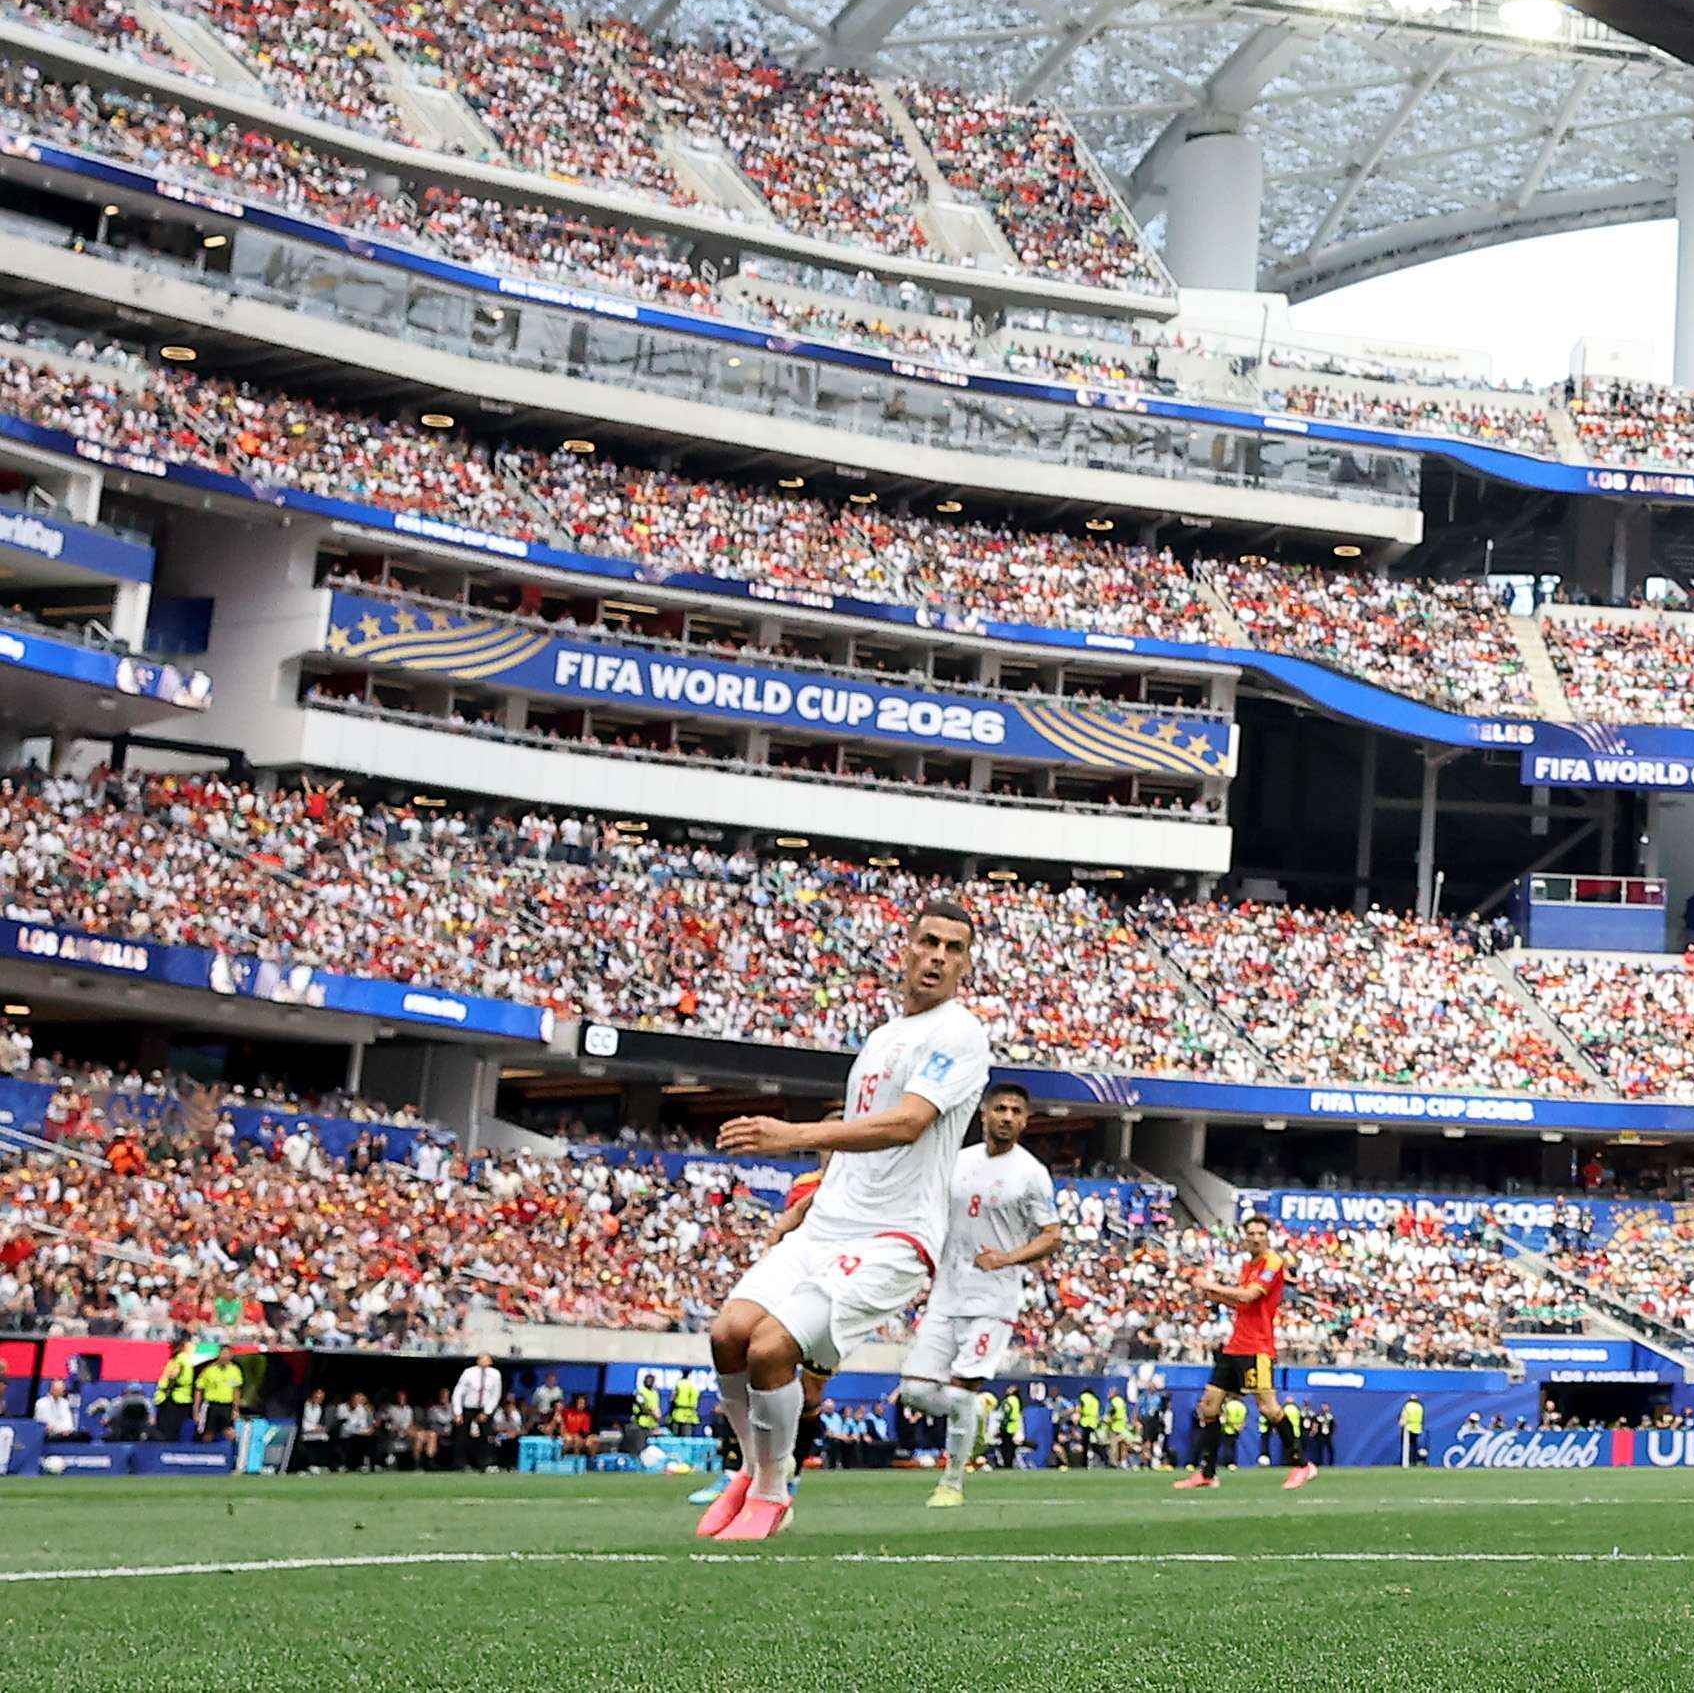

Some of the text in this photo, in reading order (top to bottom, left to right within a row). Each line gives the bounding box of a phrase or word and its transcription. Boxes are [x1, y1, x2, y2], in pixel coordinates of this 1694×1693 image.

[555, 650, 1006, 745] FIFA WORLD CUP 2026
[1535, 756, 1592, 783] FIFA
[1594, 759, 1690, 786] WORLD
[1281, 1194, 1339, 1222] FIFA
[975, 1333, 990, 1356] 8
[1443, 1422, 1601, 1468] Michelob
